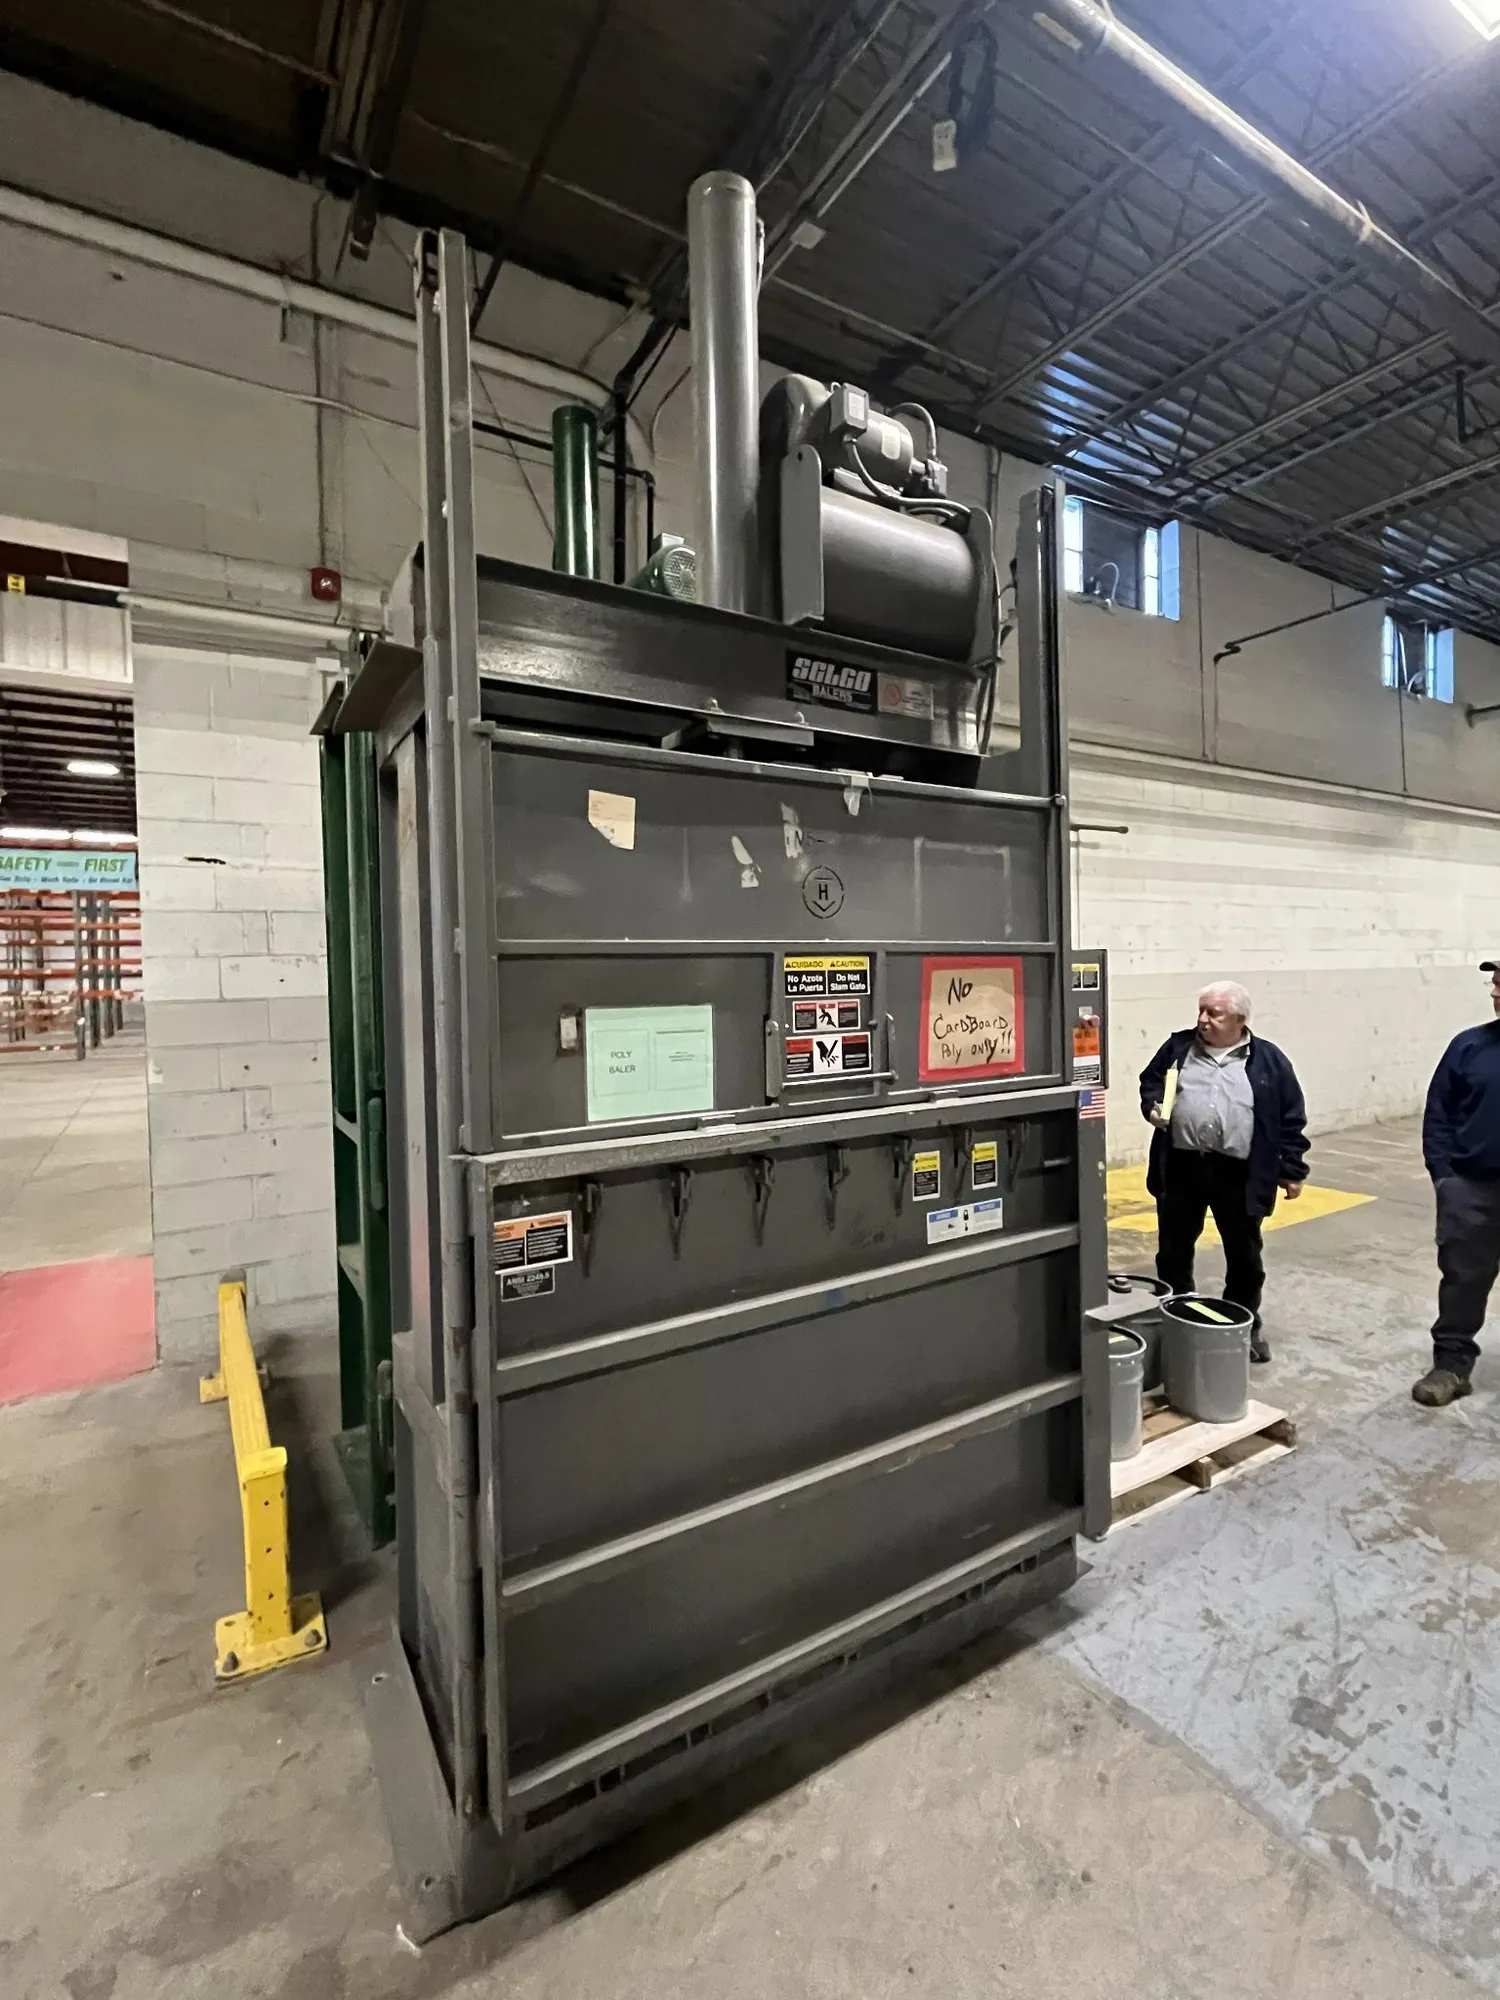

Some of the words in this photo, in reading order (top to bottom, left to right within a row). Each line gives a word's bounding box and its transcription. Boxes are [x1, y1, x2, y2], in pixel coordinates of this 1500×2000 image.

[792, 657, 872, 692] SELCO
[812, 684, 853, 702] BALERS
[0, 856, 52, 871] SAFETY
[85, 858, 128, 872] FIRST
[791, 960, 824, 968] CUIDADO
[835, 960, 865, 968] CAUTION
[787, 974, 799, 983] No
[801, 974, 823, 983] Azote
[836, 973, 846, 982] Do
[847, 973, 860, 982] Not
[787, 984, 797, 992] La
[799, 983, 824, 992] Puerta
[830, 983, 848, 991] Slam
[849, 982, 866, 990] Gate
[948, 977, 973, 1006] No
[610, 1050, 632, 1060] POLY
[608, 1064, 637, 1074] BALER
